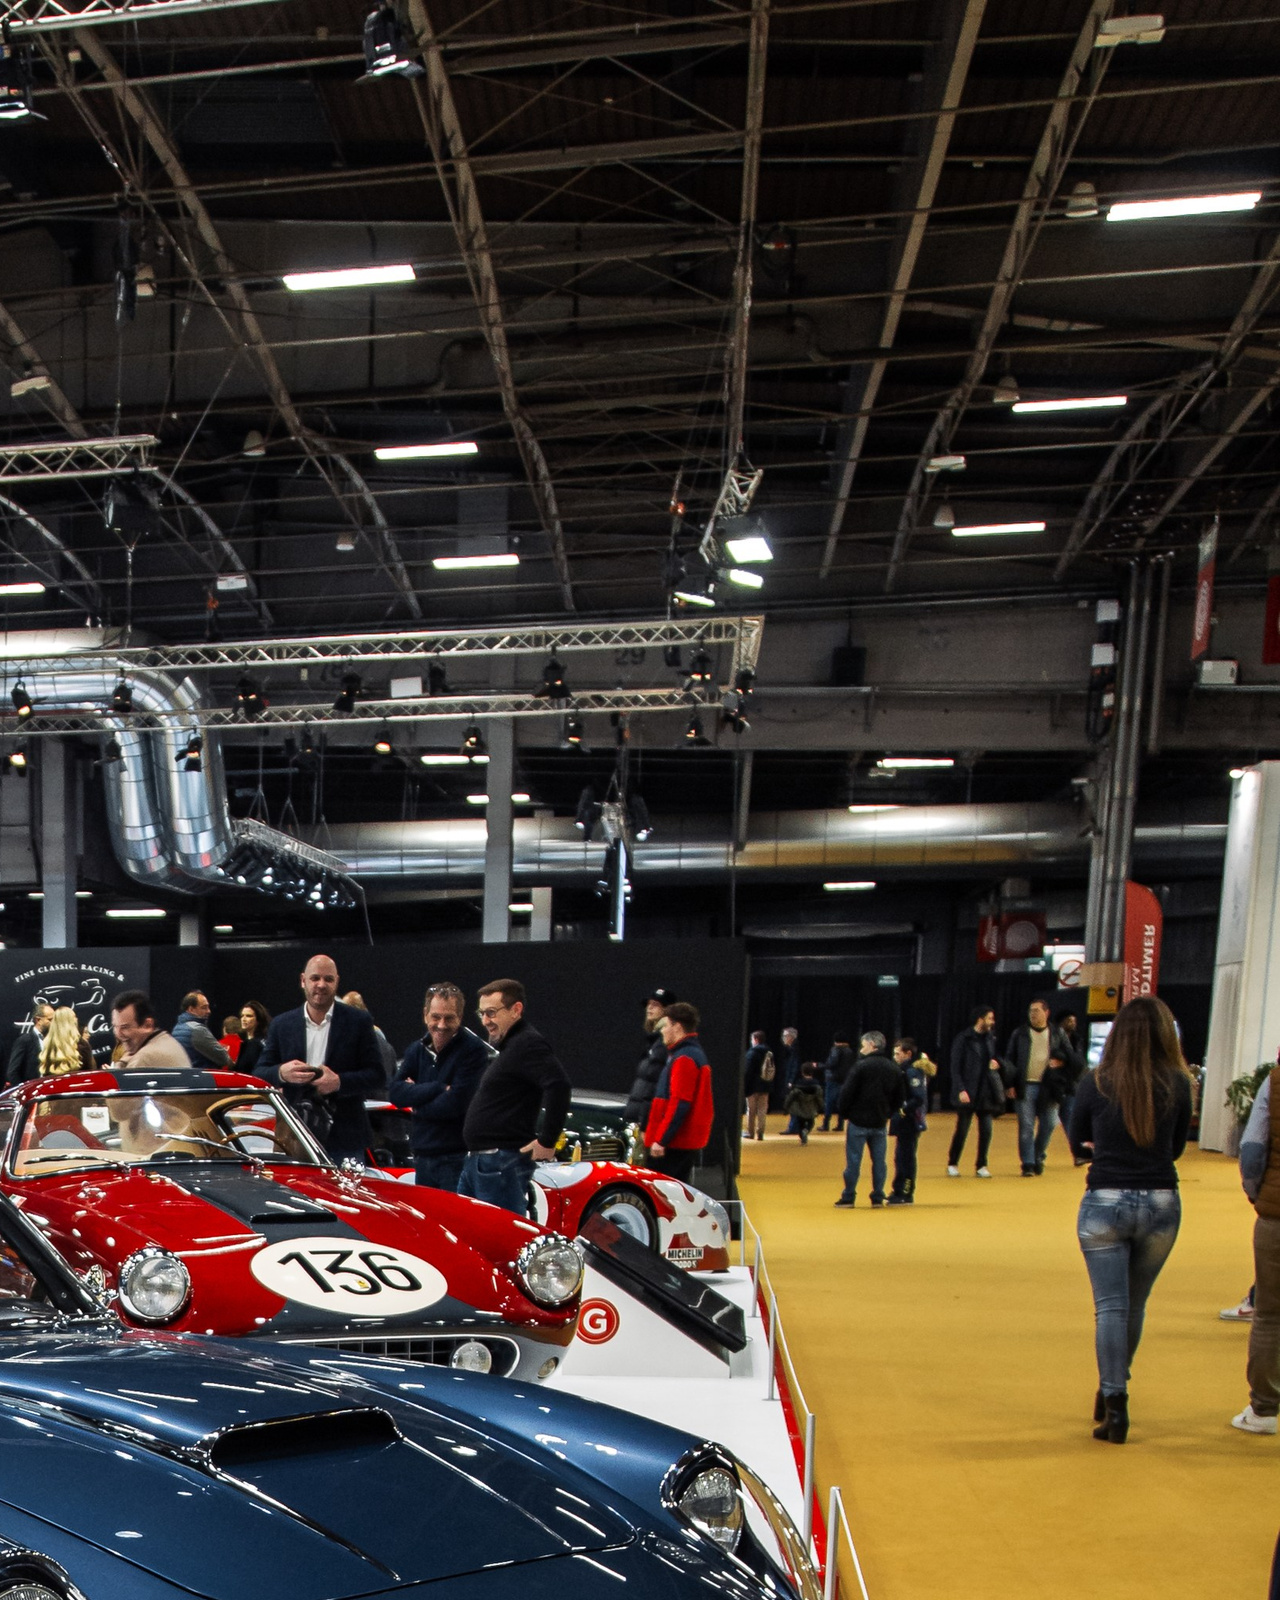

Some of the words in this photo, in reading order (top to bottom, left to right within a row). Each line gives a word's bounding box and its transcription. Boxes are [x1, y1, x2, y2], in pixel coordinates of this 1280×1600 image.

[15, 970, 35, 983] FINE
[81, 963, 116, 978] RACING
[117, 974, 125, 982] &
[668, 1249, 703, 1259] MICHELIN
[277, 1250, 422, 1295] 136
[583, 1308, 608, 1334] G
